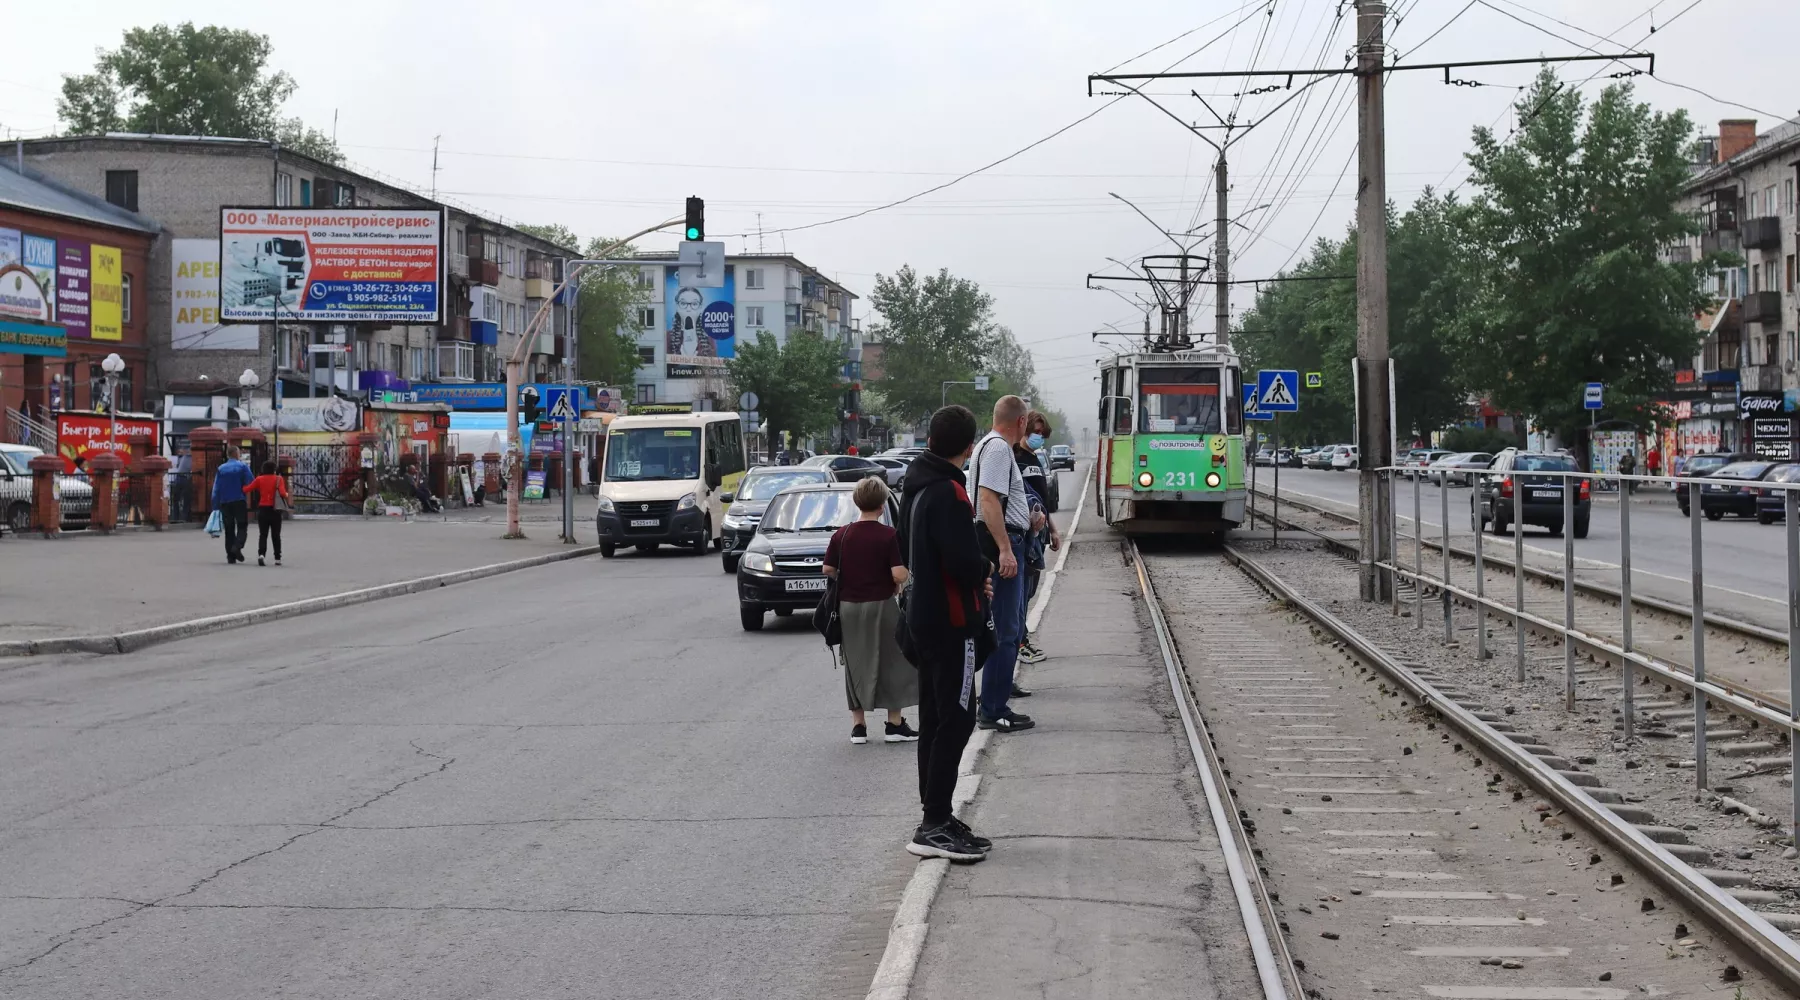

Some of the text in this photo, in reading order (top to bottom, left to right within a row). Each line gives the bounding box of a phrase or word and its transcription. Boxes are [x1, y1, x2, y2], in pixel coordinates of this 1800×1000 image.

[227, 212, 257, 225] ООО
[26, 239, 53, 266] КУХНИ
[314, 247, 434, 257] ЖЕЛЕЗОБЕТОННЫЕ ИЗДЕЛИЯ
[315, 258, 357, 268] РАСТВОР,
[359, 258, 388, 267] БЕТОН
[351, 269, 403, 279] доставкой
[352, 283, 393, 293] 30-26-72;
[394, 284, 433, 293] 30-26-73
[354, 294, 412, 302] 905-982-5141
[224, 308, 262, 317] Высокое
[373, 312, 434, 321] гарантируем!
[704, 312, 734, 322] 2000+
[1741, 396, 1782, 411] Galaxy
[1165, 471, 1195, 487] 231
